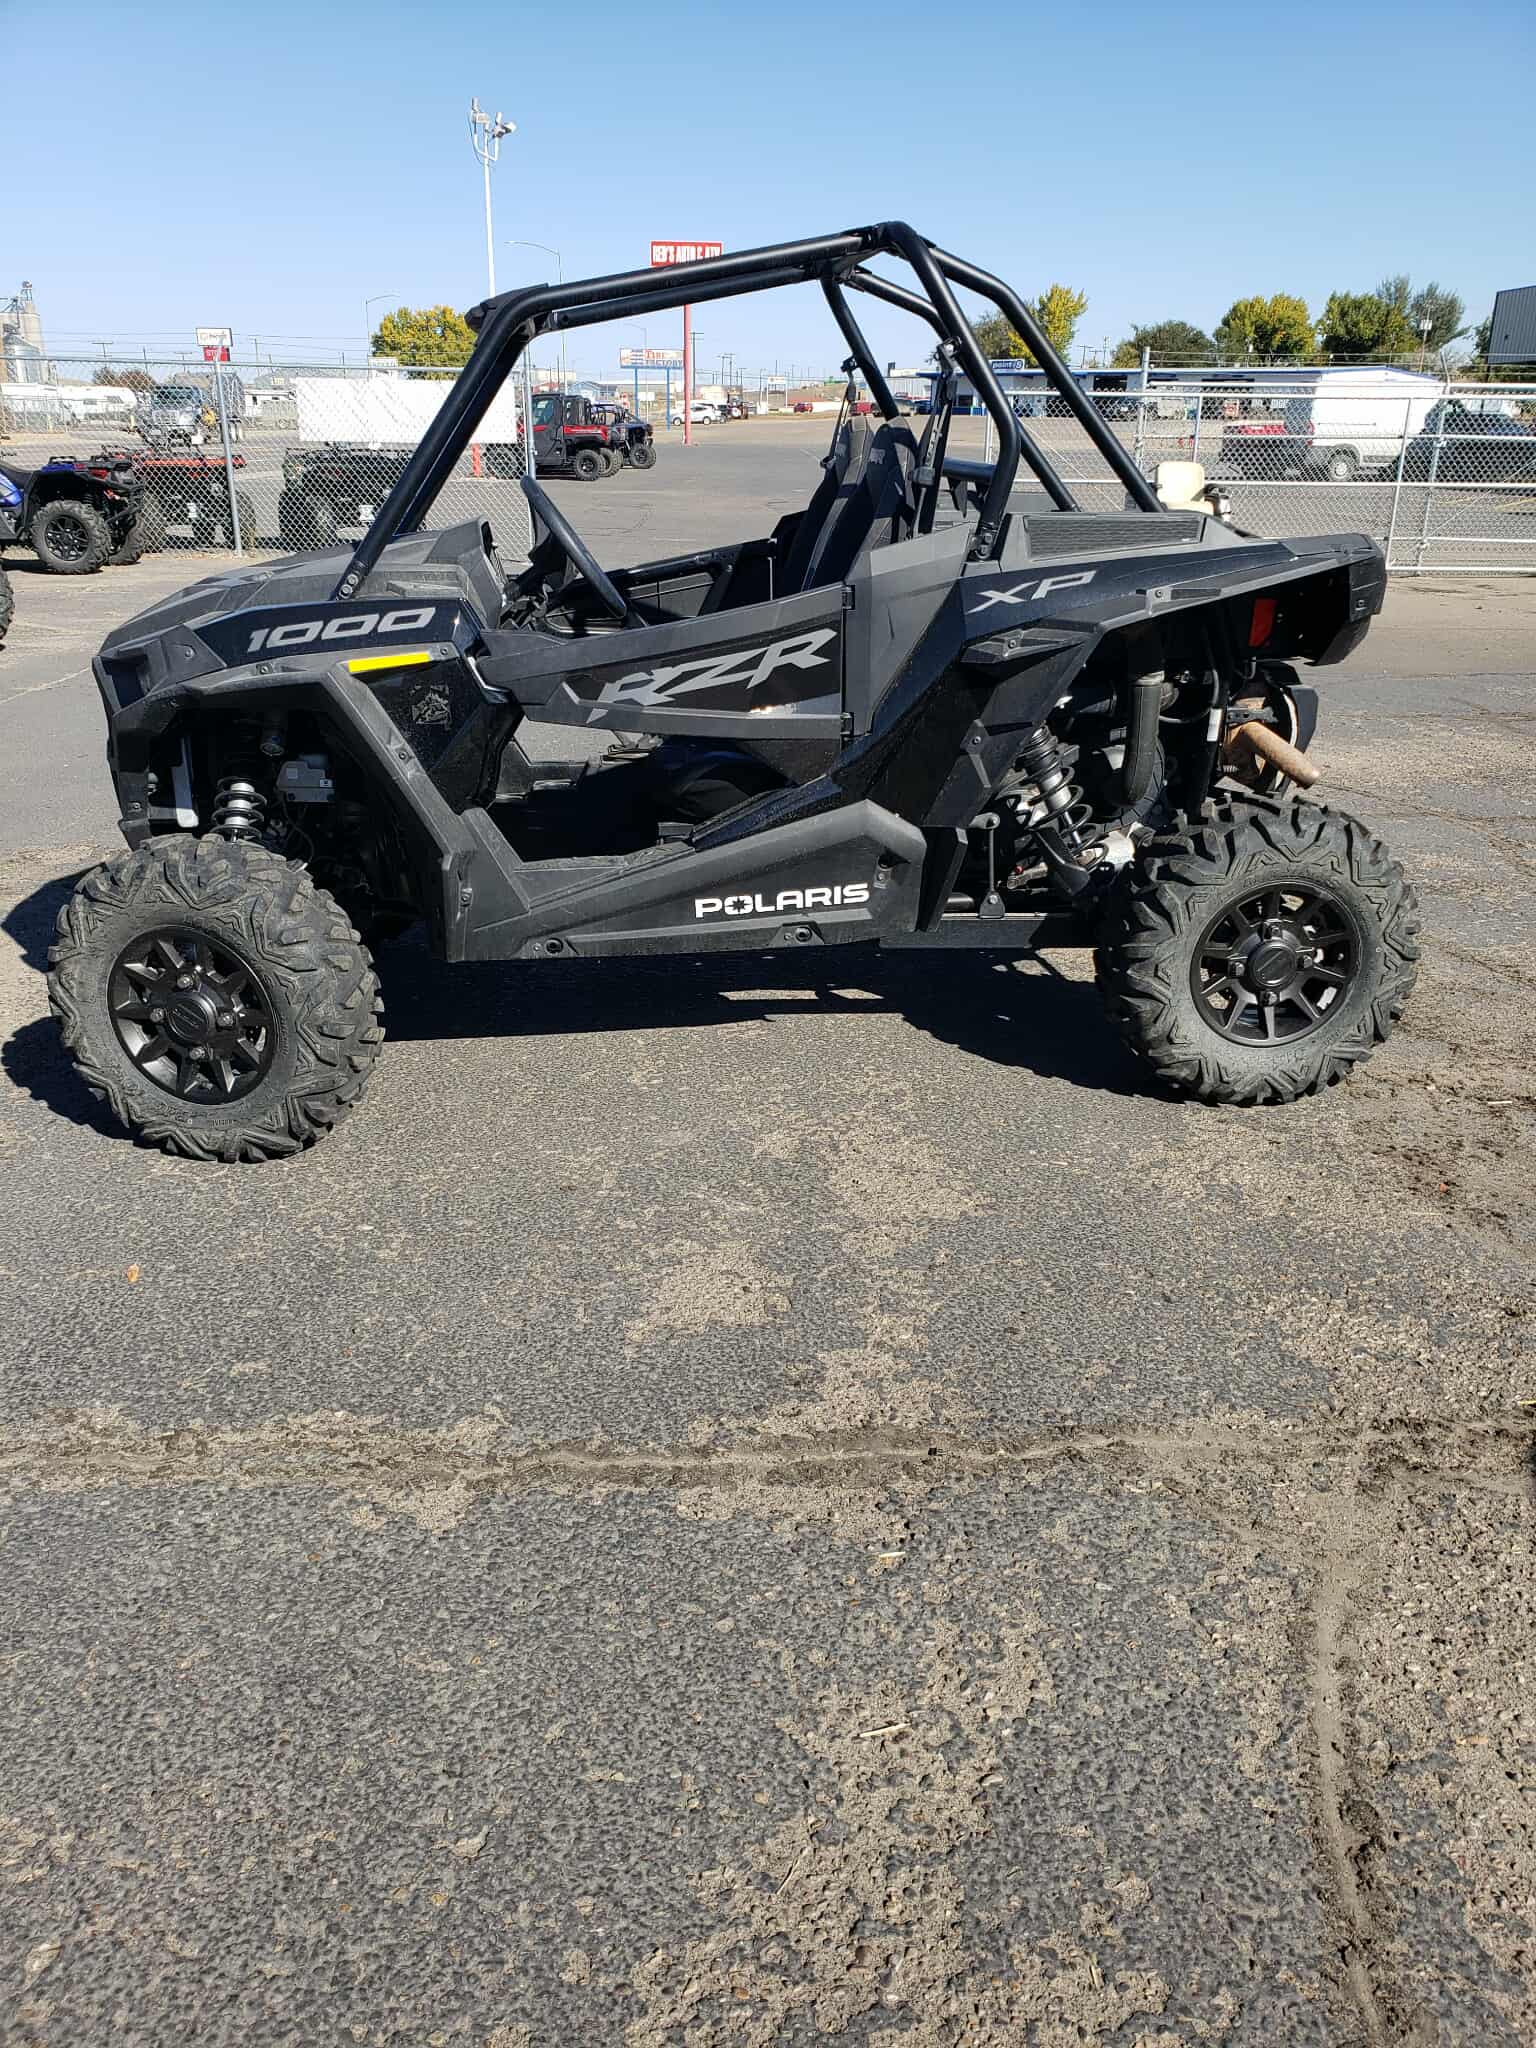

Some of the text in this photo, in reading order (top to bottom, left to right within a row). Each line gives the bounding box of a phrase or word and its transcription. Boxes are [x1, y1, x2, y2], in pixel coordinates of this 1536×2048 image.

[676, 245, 696, 262] AUTO
[968, 571, 1095, 613] XP
[248, 608, 436, 653] 1000
[588, 629, 837, 721] RZR
[695, 883, 869, 917] POLARIS
